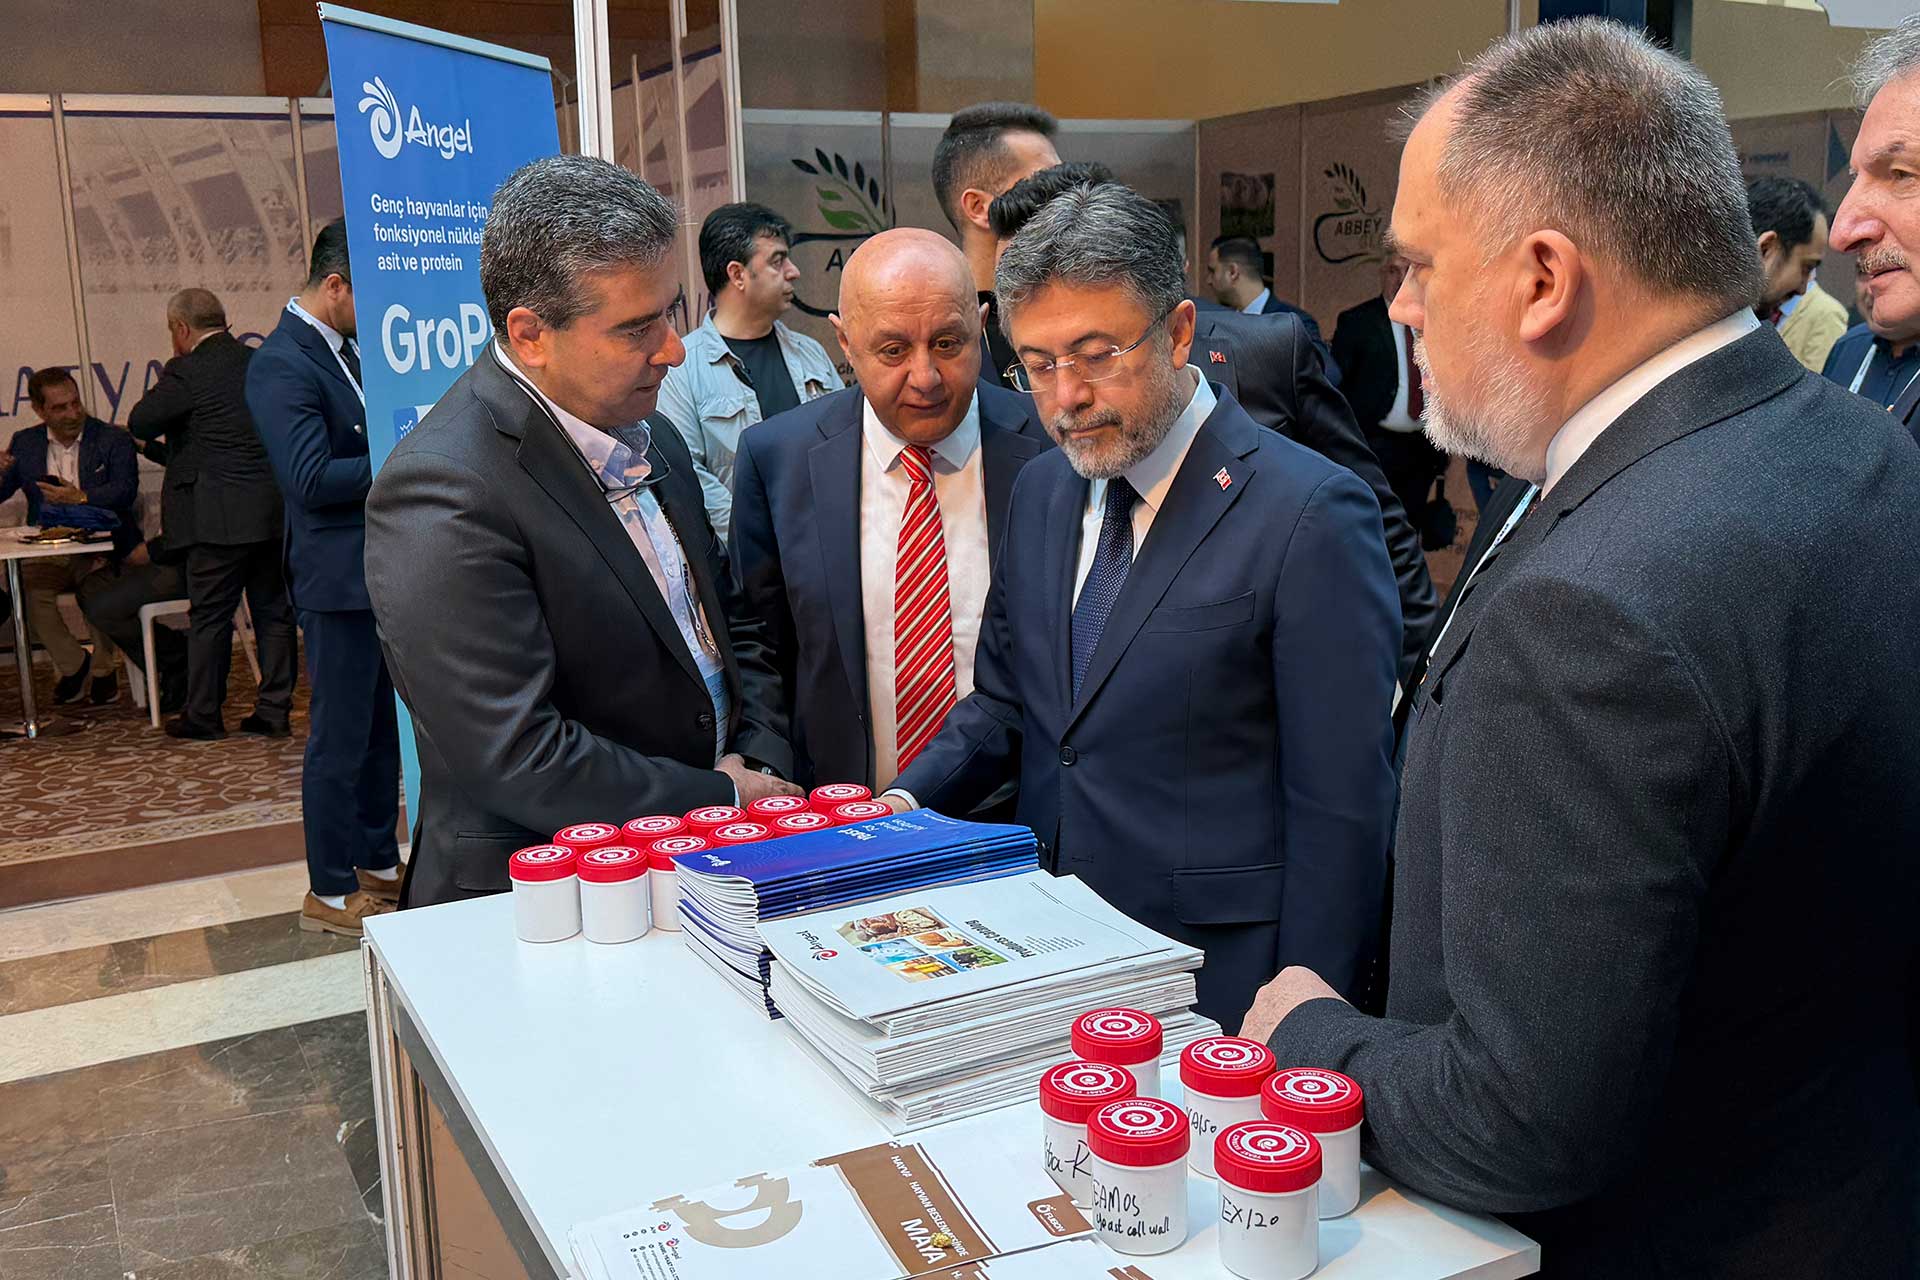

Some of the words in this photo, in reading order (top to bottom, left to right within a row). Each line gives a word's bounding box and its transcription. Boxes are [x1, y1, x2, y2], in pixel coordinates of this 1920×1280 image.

[404, 105, 474, 160] Angel
[371, 193, 404, 219] Genç
[406, 196, 466, 219] hayvanlar
[468, 201, 488, 223] için
[373, 222, 447, 247] fonksiyonel
[1334, 217, 1382, 237] ABBEY
[377, 252, 402, 271] asit
[402, 256, 418, 271] ve
[420, 254, 463, 275] protein
[381, 303, 495, 374] GroP
[909, 1181, 933, 1208] HAYVAN
[900, 1217, 948, 1265] MAYA
